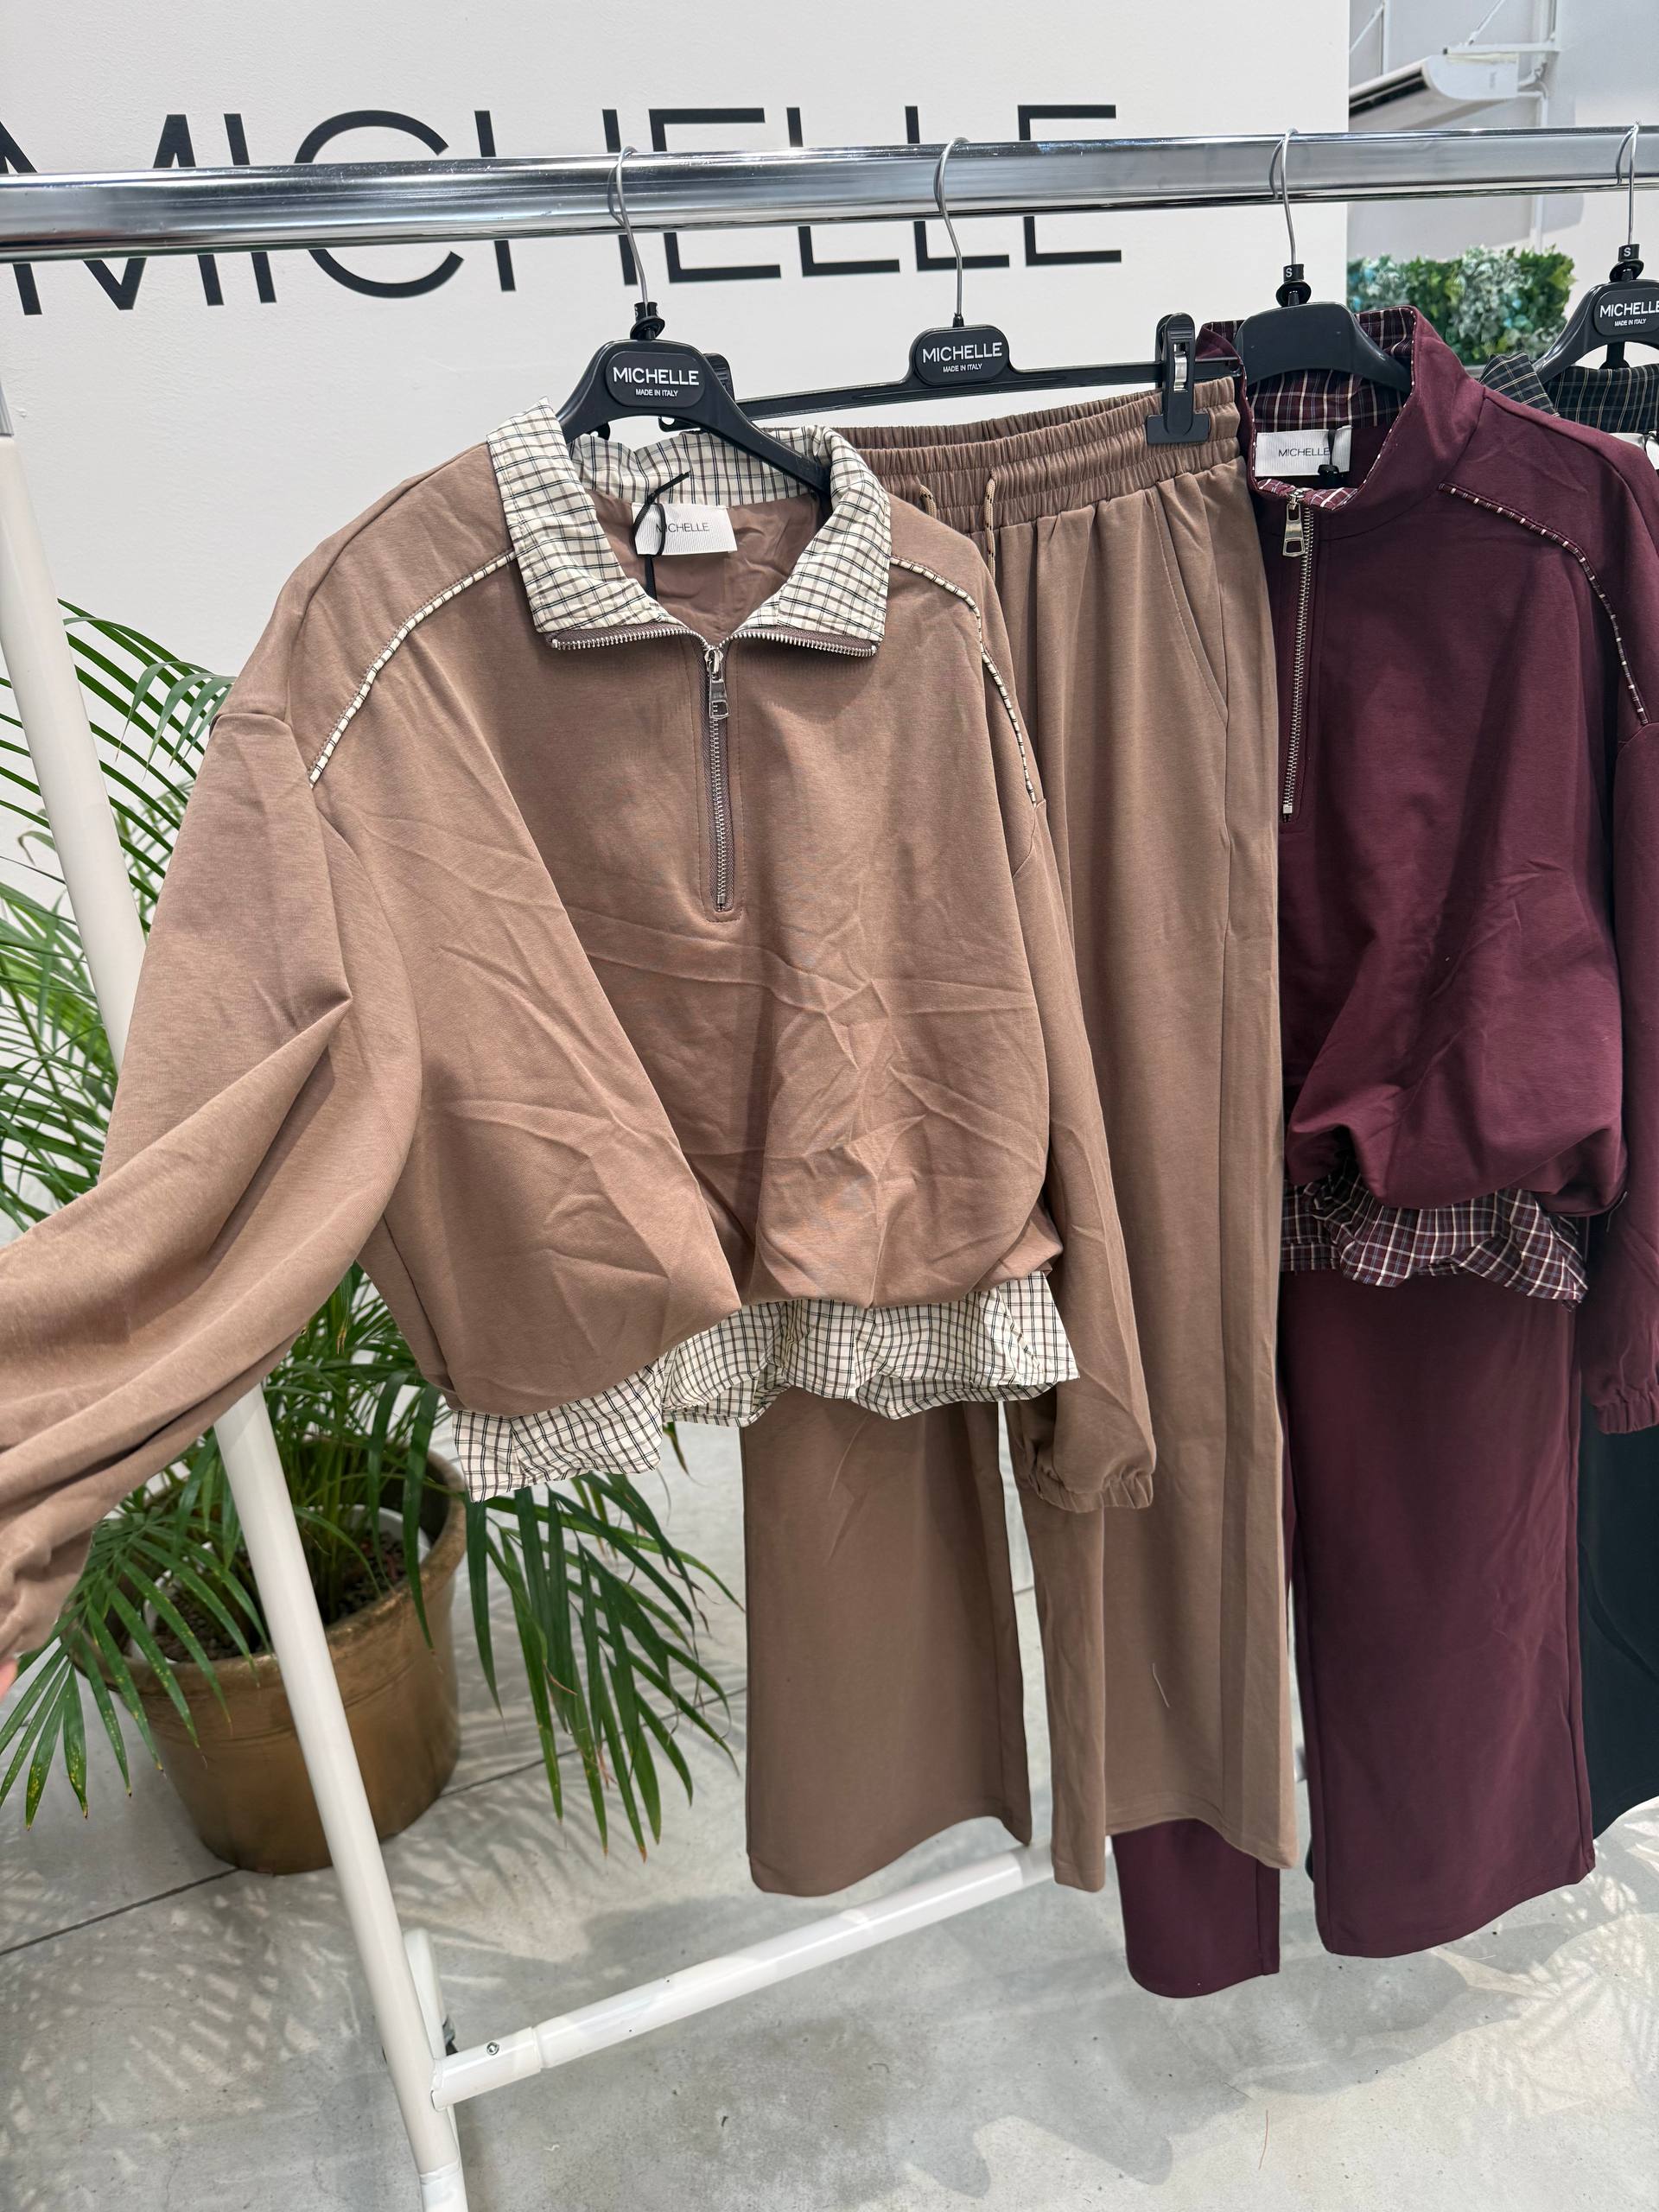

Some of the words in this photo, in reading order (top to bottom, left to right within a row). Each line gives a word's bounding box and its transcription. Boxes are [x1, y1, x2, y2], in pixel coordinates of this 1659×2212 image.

[1624, 246, 1631, 257] S
[1285, 267, 1293, 277] S
[922, 341, 1002, 363] MICHELLE
[943, 365, 959, 373] MADE
[613, 366, 700, 386] MICHELLE
[635, 388, 653, 397] MADE
[661, 389, 678, 397] ITALY
[1278, 447, 1331, 457] MICHELLE
